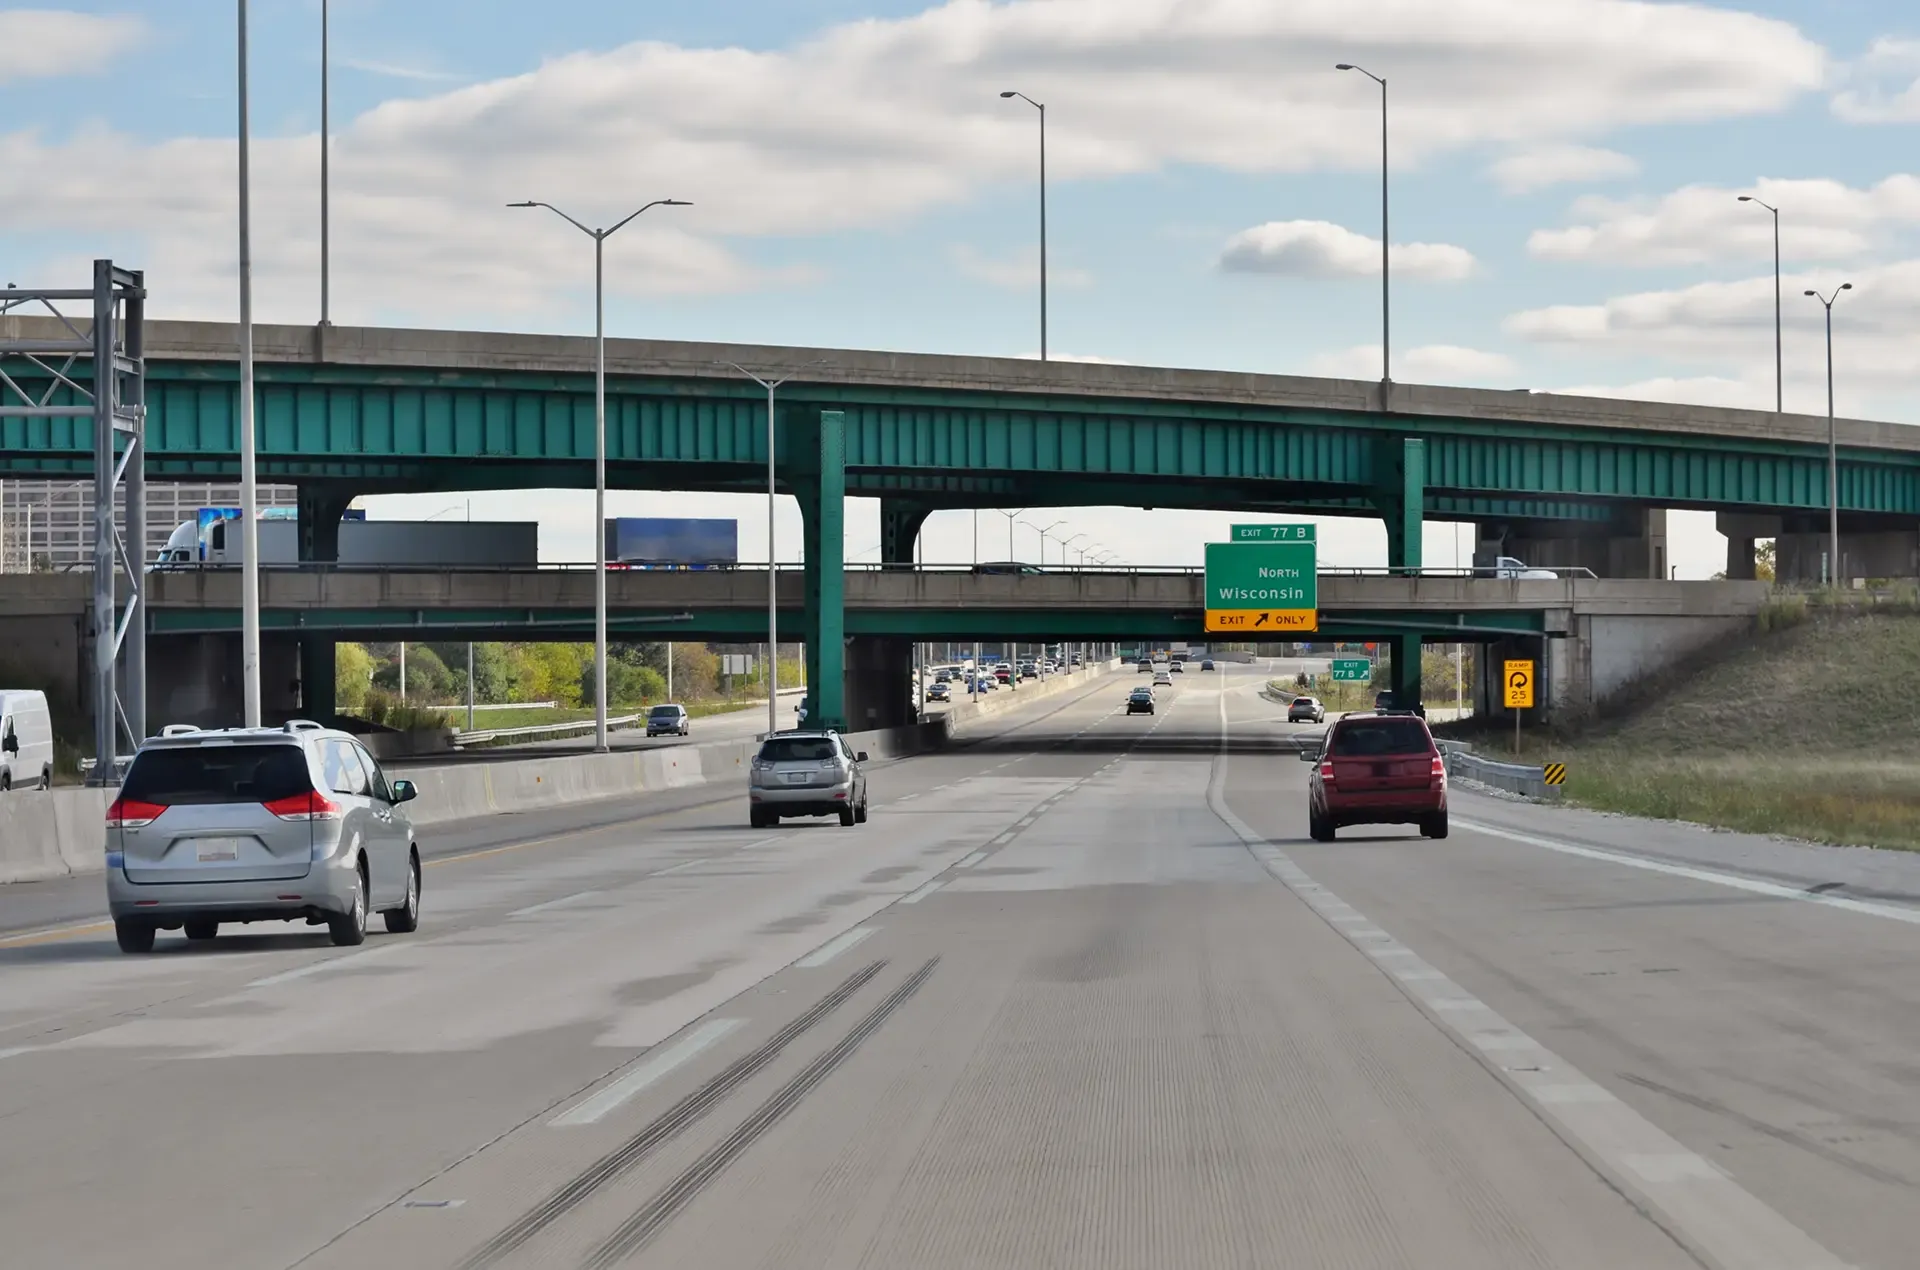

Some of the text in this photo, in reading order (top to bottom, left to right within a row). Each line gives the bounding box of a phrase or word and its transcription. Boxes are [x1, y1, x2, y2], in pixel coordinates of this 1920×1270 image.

[1241, 528, 1306, 538] EXIT 77 B
[1258, 567, 1299, 578] NORTH
[1219, 588, 1304, 600] Wisconsin
[1220, 616, 1306, 625] EXIT ONLY
[1334, 670, 1355, 678] 77 B
[1511, 690, 1526, 700] 25
